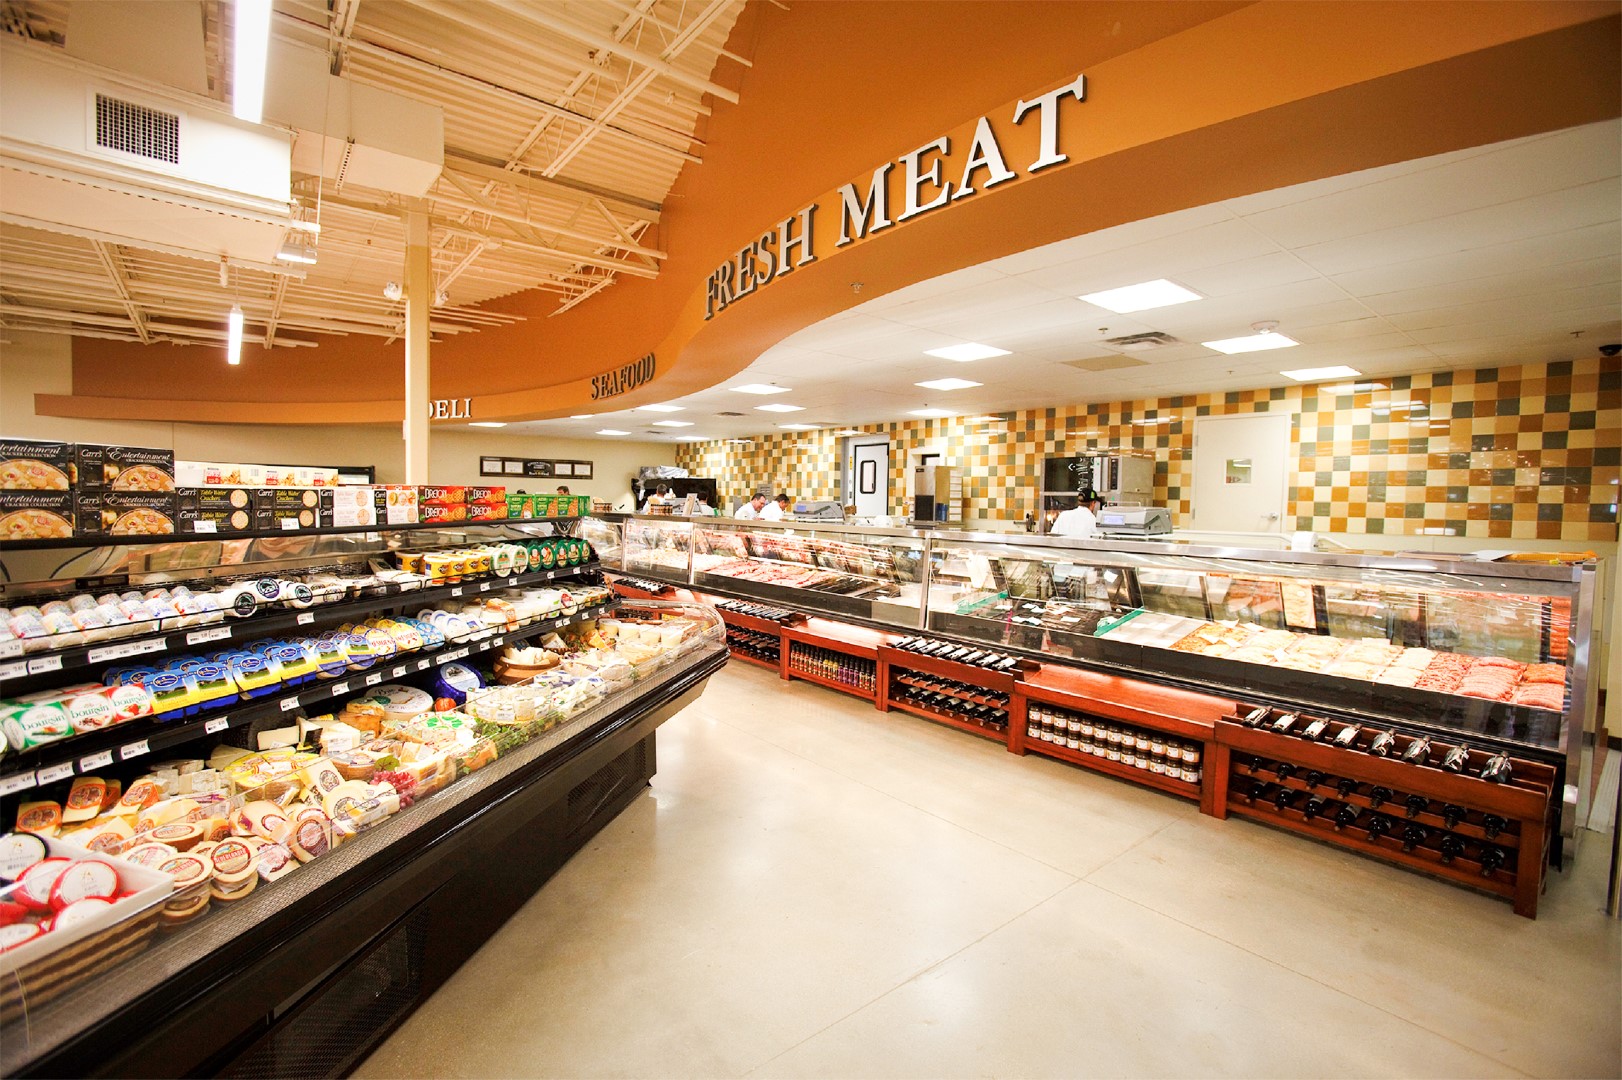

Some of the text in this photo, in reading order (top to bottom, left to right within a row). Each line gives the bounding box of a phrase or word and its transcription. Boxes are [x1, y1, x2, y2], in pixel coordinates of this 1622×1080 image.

[704, 74, 1087, 321] FRESH MEAT
[591, 352, 656, 399] SEAFOOD
[429, 397, 473, 419] ELI
[106, 446, 171, 461] Entertainment
[103, 493, 169, 506] Entertainment
[112, 694, 148, 707] boursin
[70, 705, 110, 719] boursin
[22, 714, 65, 731] boursin
